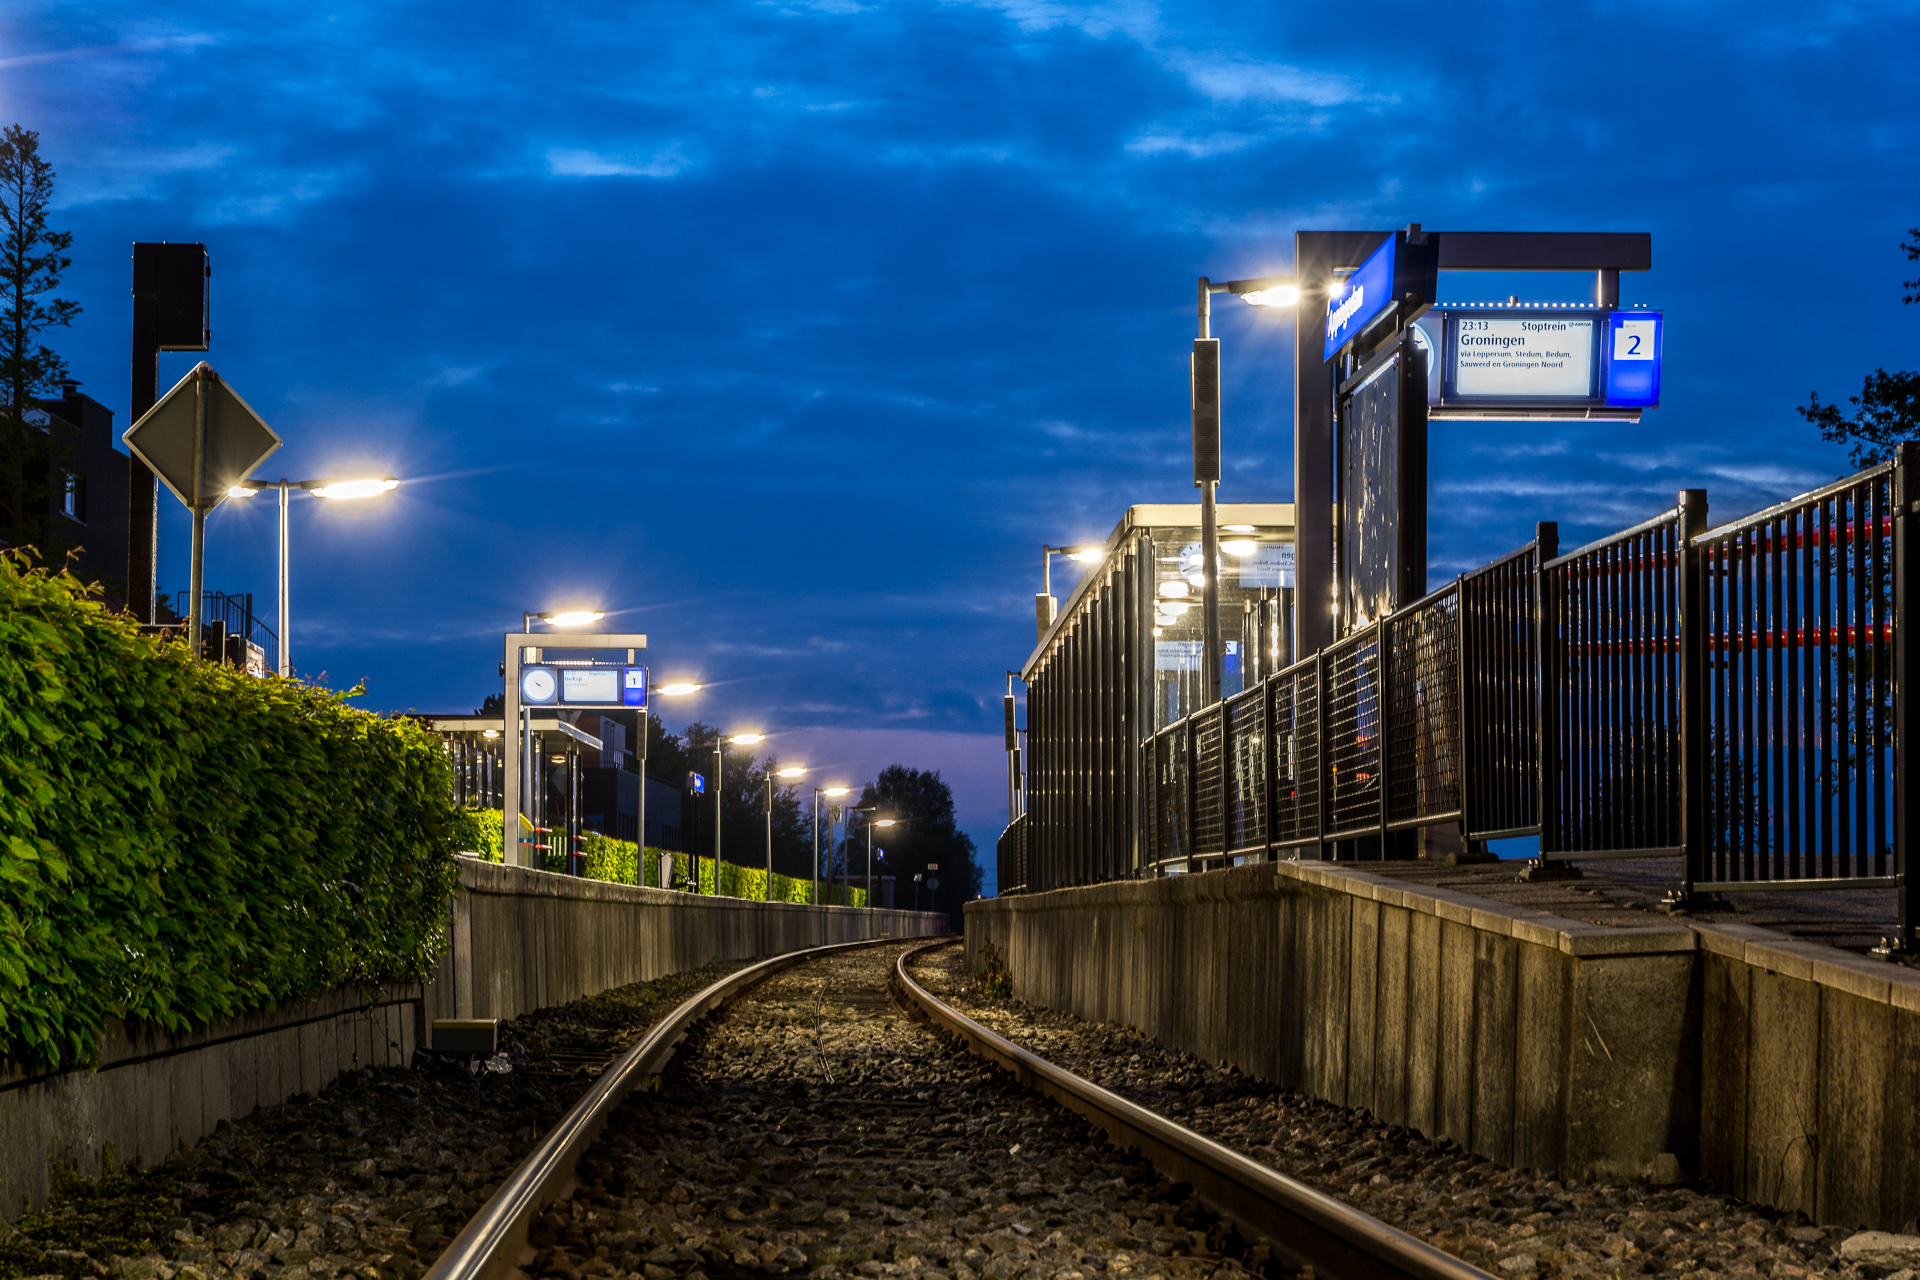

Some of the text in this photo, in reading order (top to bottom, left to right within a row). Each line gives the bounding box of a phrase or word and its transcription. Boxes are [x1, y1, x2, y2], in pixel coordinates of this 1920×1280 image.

[1327, 284, 1364, 341] Appingedam
[1462, 321, 1567, 333] 23:13 Stoptrein
[1461, 334, 1525, 349] Groningen
[1627, 335, 1642, 355] 2
[1473, 351, 1513, 359] Loppersum,
[1545, 350, 1572, 359] Bedum,
[1460, 360, 1491, 368] Sauwerd
[1502, 360, 1540, 369] Groningen
[1541, 360, 1564, 368] Noord
